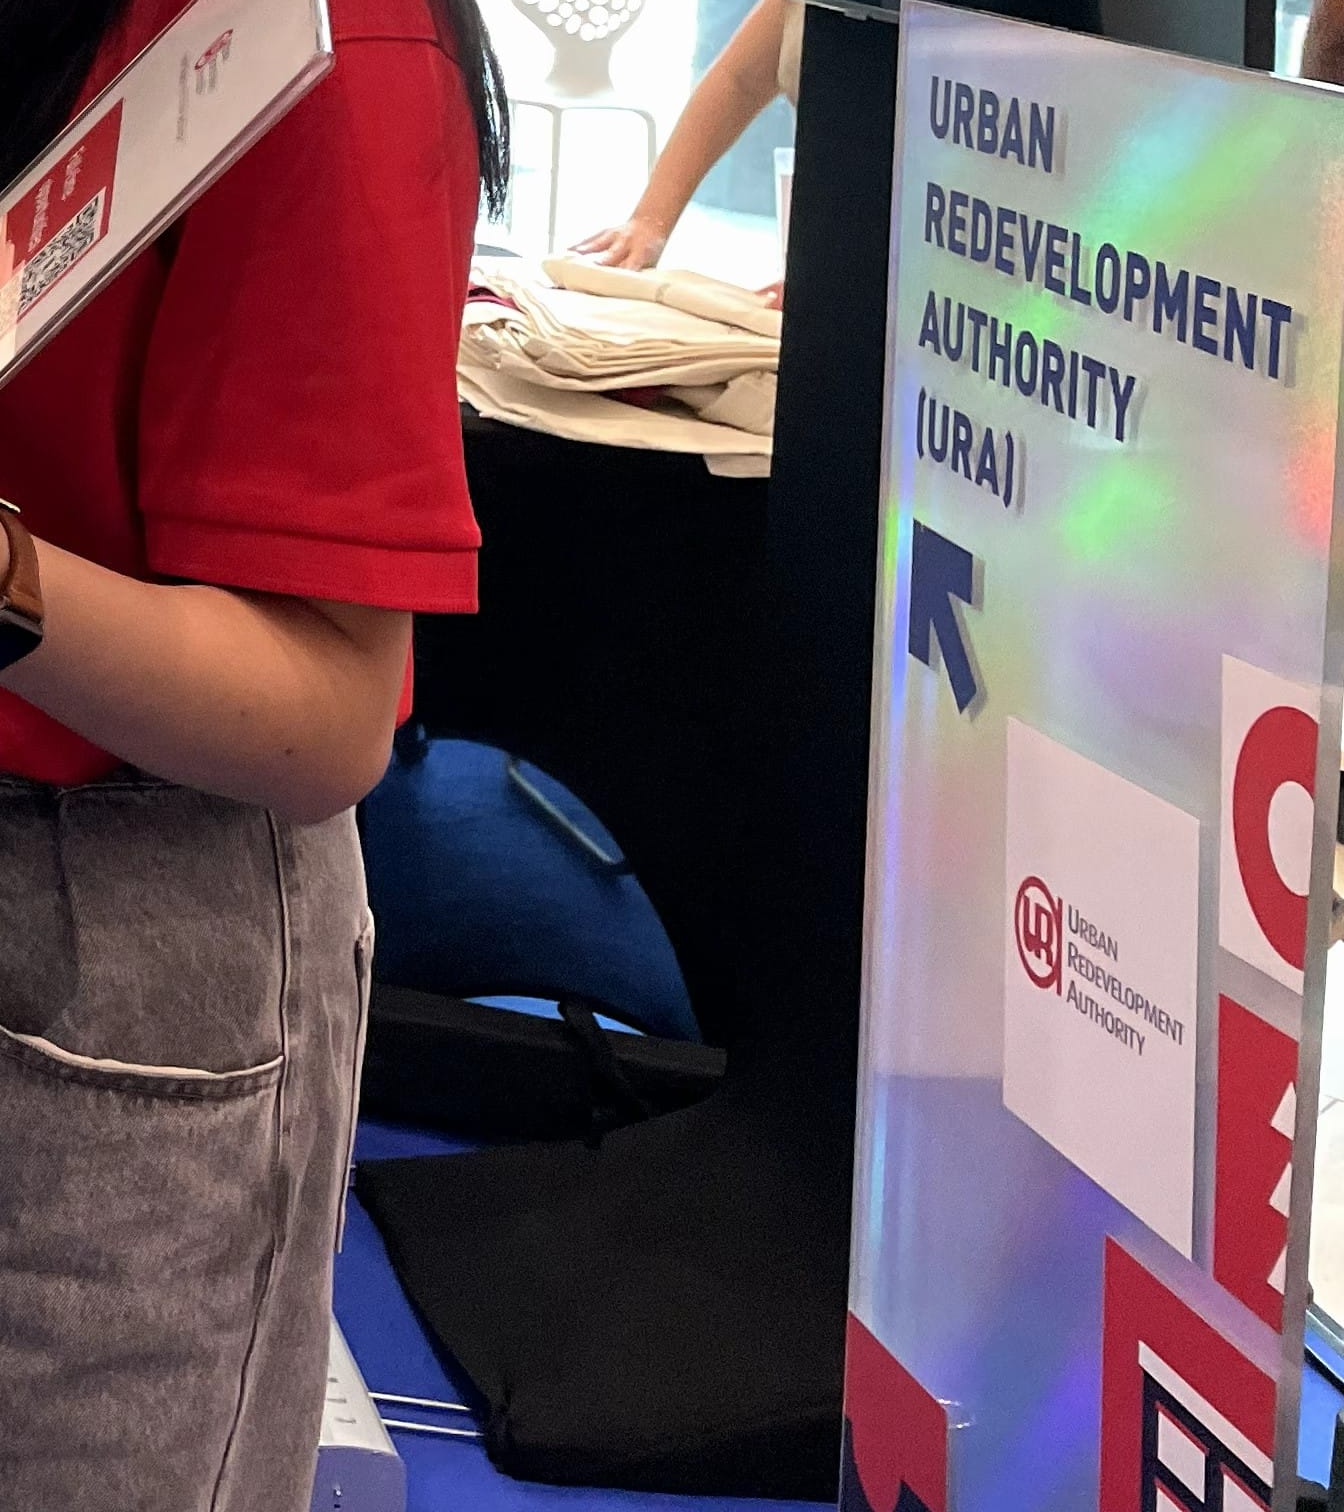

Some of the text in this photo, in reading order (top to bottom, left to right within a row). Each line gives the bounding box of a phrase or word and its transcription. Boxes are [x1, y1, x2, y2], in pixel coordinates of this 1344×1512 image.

[929, 76, 1055, 173] URBAN
[925, 181, 1293, 380] REDEVELOPMENT
[919, 290, 1136, 443] AUTHORITY
[917, 387, 1013, 508] (URA)
[1068, 904, 1118, 962] URBAN
[1066, 979, 1146, 1056] AUTHORITY
[1067, 941, 1185, 1045] REDEVELOPMENT
